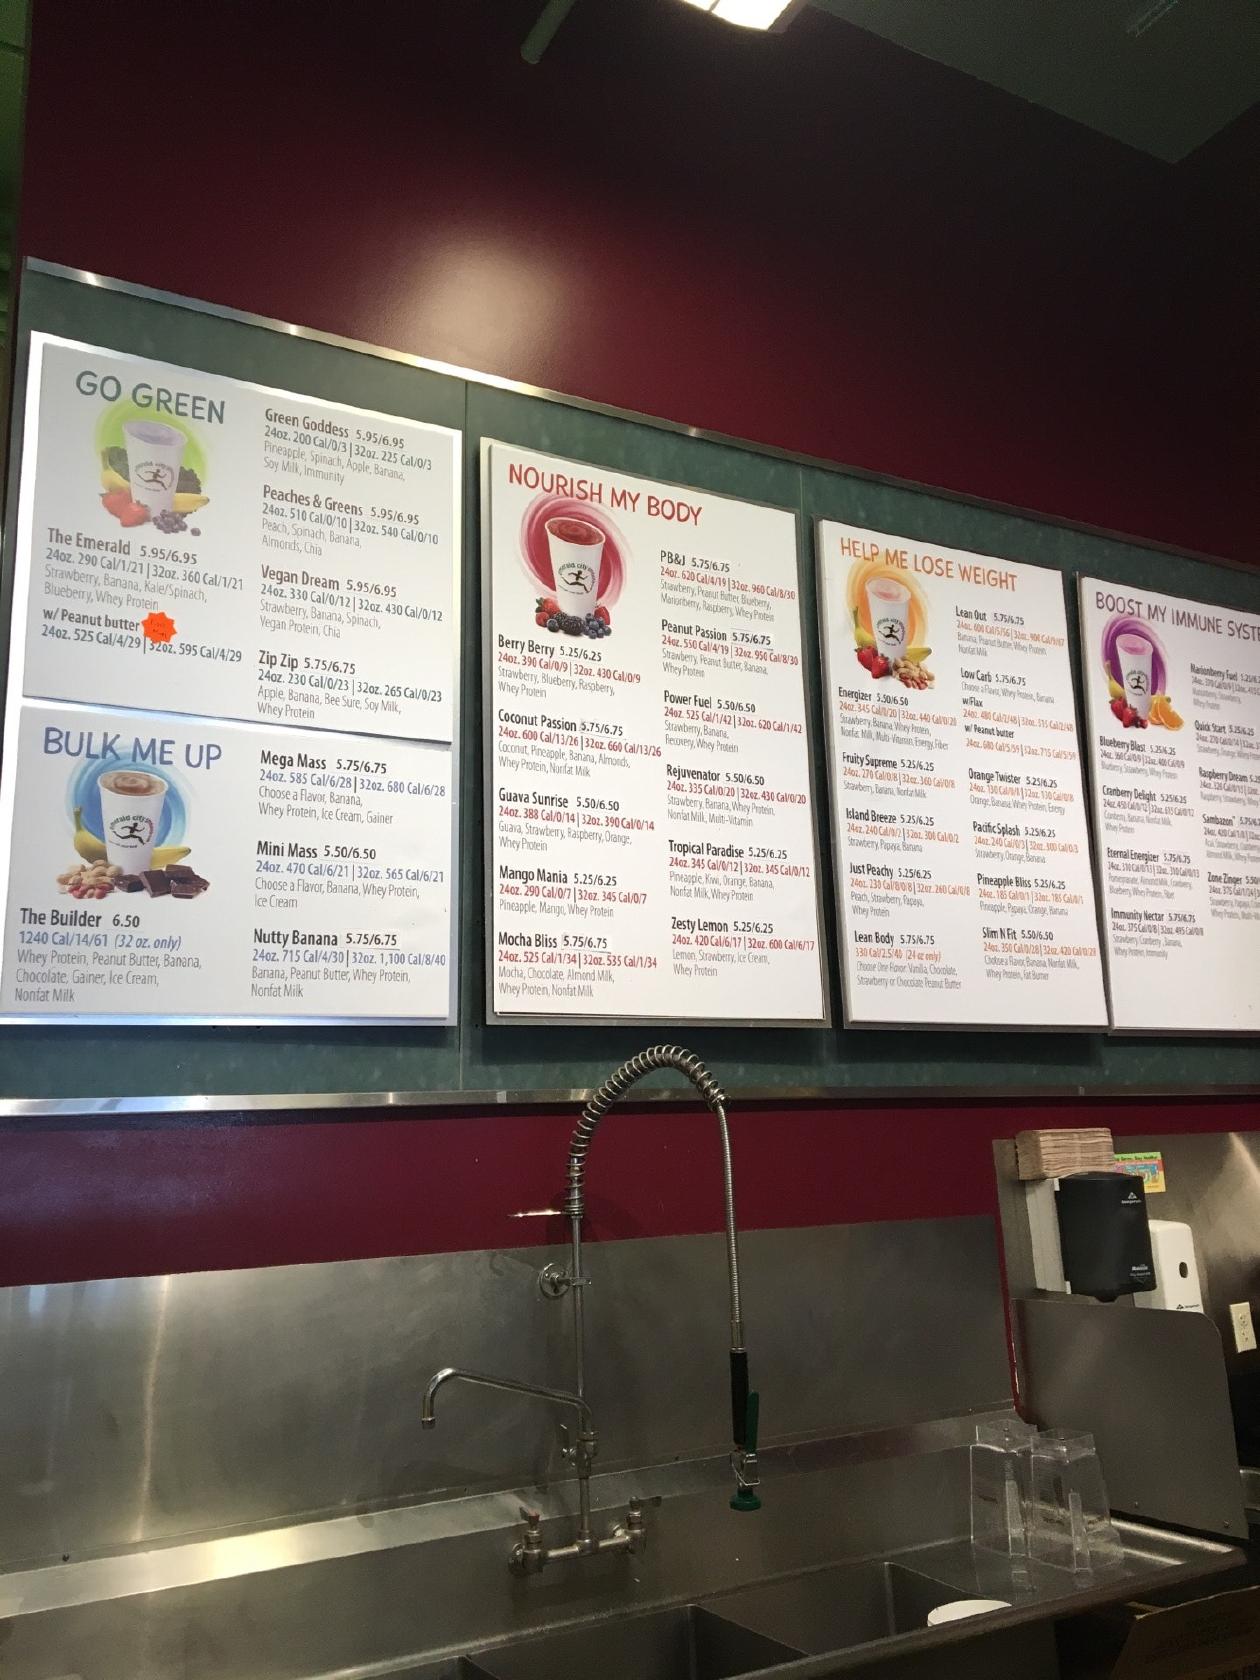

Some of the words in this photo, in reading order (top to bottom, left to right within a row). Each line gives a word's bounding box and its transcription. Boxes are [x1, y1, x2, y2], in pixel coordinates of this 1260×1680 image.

[75, 369, 122, 402] GO
[131, 382, 225, 425] GREEN
[264, 407, 299, 428] Green
[302, 415, 349, 439] Goddess
[355, 428, 405, 449] 5.95/6.95
[262, 483, 311, 507] Peaches
[312, 493, 322, 509] &
[324, 496, 363, 516] Greens
[369, 506, 420, 526] 5.95/6.95
[508, 463, 603, 504] NOURISH
[610, 486, 641, 513] MY
[646, 494, 703, 526] BODY
[47, 527, 73, 546] The
[75, 531, 131, 556] Emerald
[139, 544, 197, 565] 5.95/6.95
[660, 549, 686, 567] PB&J
[690, 556, 730, 573] 5.75/6.75
[840, 536, 880, 562] HELP
[913, 553, 954, 579] LOSE
[957, 562, 1018, 592] WEIGHT
[260, 563, 298, 585] Vegan
[301, 570, 340, 591] Dream
[345, 578, 397, 598] 5.95/6.95
[42, 607, 60, 621] w/
[60, 608, 102, 627] Peanut
[103, 613, 140, 632] butter
[1095, 590, 1143, 618] BOOST
[1171, 607, 1223, 635] IMMUNE
[661, 618, 694, 636] Peanut
[695, 624, 727, 642] Passion
[731, 631, 771, 646] 5.75/6.75
[498, 633, 526, 655] Berry
[527, 639, 555, 659] Berry
[559, 645, 602, 662] 5.25/6.25
[258, 649, 278, 669] Zip
[279, 652, 299, 672] Zip
[303, 656, 356, 675] 5.75/6.75
[663, 689, 692, 706] Power
[693, 694, 712, 709] Fuel
[716, 698, 756, 713] 5.50/6.50
[837, 685, 872, 703] Energizer
[497, 708, 538, 727] Coconut
[540, 714, 577, 732] Passion
[580, 721, 623, 737] 5.75/6.75
[43, 726, 122, 764] BULK
[131, 736, 176, 767] ME
[184, 743, 222, 770] UP
[260, 749, 294, 769] Mega
[296, 752, 327, 770] Mass
[335, 758, 387, 774] 5.75/6.75
[842, 751, 865, 767] Fruity
[864, 753, 898, 769] Supreme
[259, 768, 287, 783] 24oz.
[289, 771, 308, 785] 585
[310, 772, 352, 789] Cal/6/28
[666, 763, 721, 782] Rejuvenator
[725, 772, 765, 786] 5.50/6.50
[967, 767, 995, 784] Orange
[994, 770, 1021, 785] Twister
[258, 784, 291, 801] Choose
[291, 790, 298, 801] a
[359, 777, 385, 792] 32oz.
[386, 780, 405, 794] 680
[406, 781, 446, 797] Cal/6/28
[498, 786, 530, 804] Guava
[531, 790, 569, 809] Sunrise
[576, 795, 620, 812] 5.50/6.50
[258, 801, 285, 819] Whey
[320, 807, 334, 821] Ice
[365, 809, 394, 825] Gainer
[845, 807, 870, 822] Island
[870, 809, 897, 824] Breeze
[972, 820, 997, 834] Pacific
[996, 822, 1021, 837] Splash
[256, 839, 284, 857] Mini
[287, 842, 318, 859] Mass
[323, 844, 376, 860] 5.50/6.50
[667, 838, 704, 857] Tropical
[705, 842, 745, 858] Paradise
[748, 846, 788, 860] 5.25/6.25
[499, 864, 535, 884] Mango
[536, 867, 568, 884] Mania
[573, 872, 617, 886] 5.25/6.25
[849, 861, 866, 875] Just
[865, 862, 894, 880] Peachy
[976, 872, 1014, 889] Pineapple
[1014, 875, 1032, 889] Bliss
[19, 907, 46, 925] The
[50, 908, 102, 928] Builder
[111, 913, 140, 928] 6.50
[671, 915, 696, 934] Zesty
[697, 917, 729, 933] Lemon
[733, 920, 774, 934] 5.25/6.25
[18, 930, 49, 945] 1240
[51, 931, 108, 947] Cal/14/61
[134, 937, 151, 949] oz.
[253, 927, 290, 947] Nutty
[291, 929, 338, 946] Banana
[345, 932, 397, 946] 5.75/6.75
[498, 931, 532, 947] Mocha
[534, 933, 558, 949] Bliss
[563, 934, 607, 949] 5.75/6.75
[853, 929, 873, 943] Lean
[874, 931, 895, 948] Body
[981, 926, 999, 939] Slim
[1005, 927, 1018, 941] Fit
[14, 987, 50, 1002] Nonfat
[51, 987, 75, 1002] Milk
